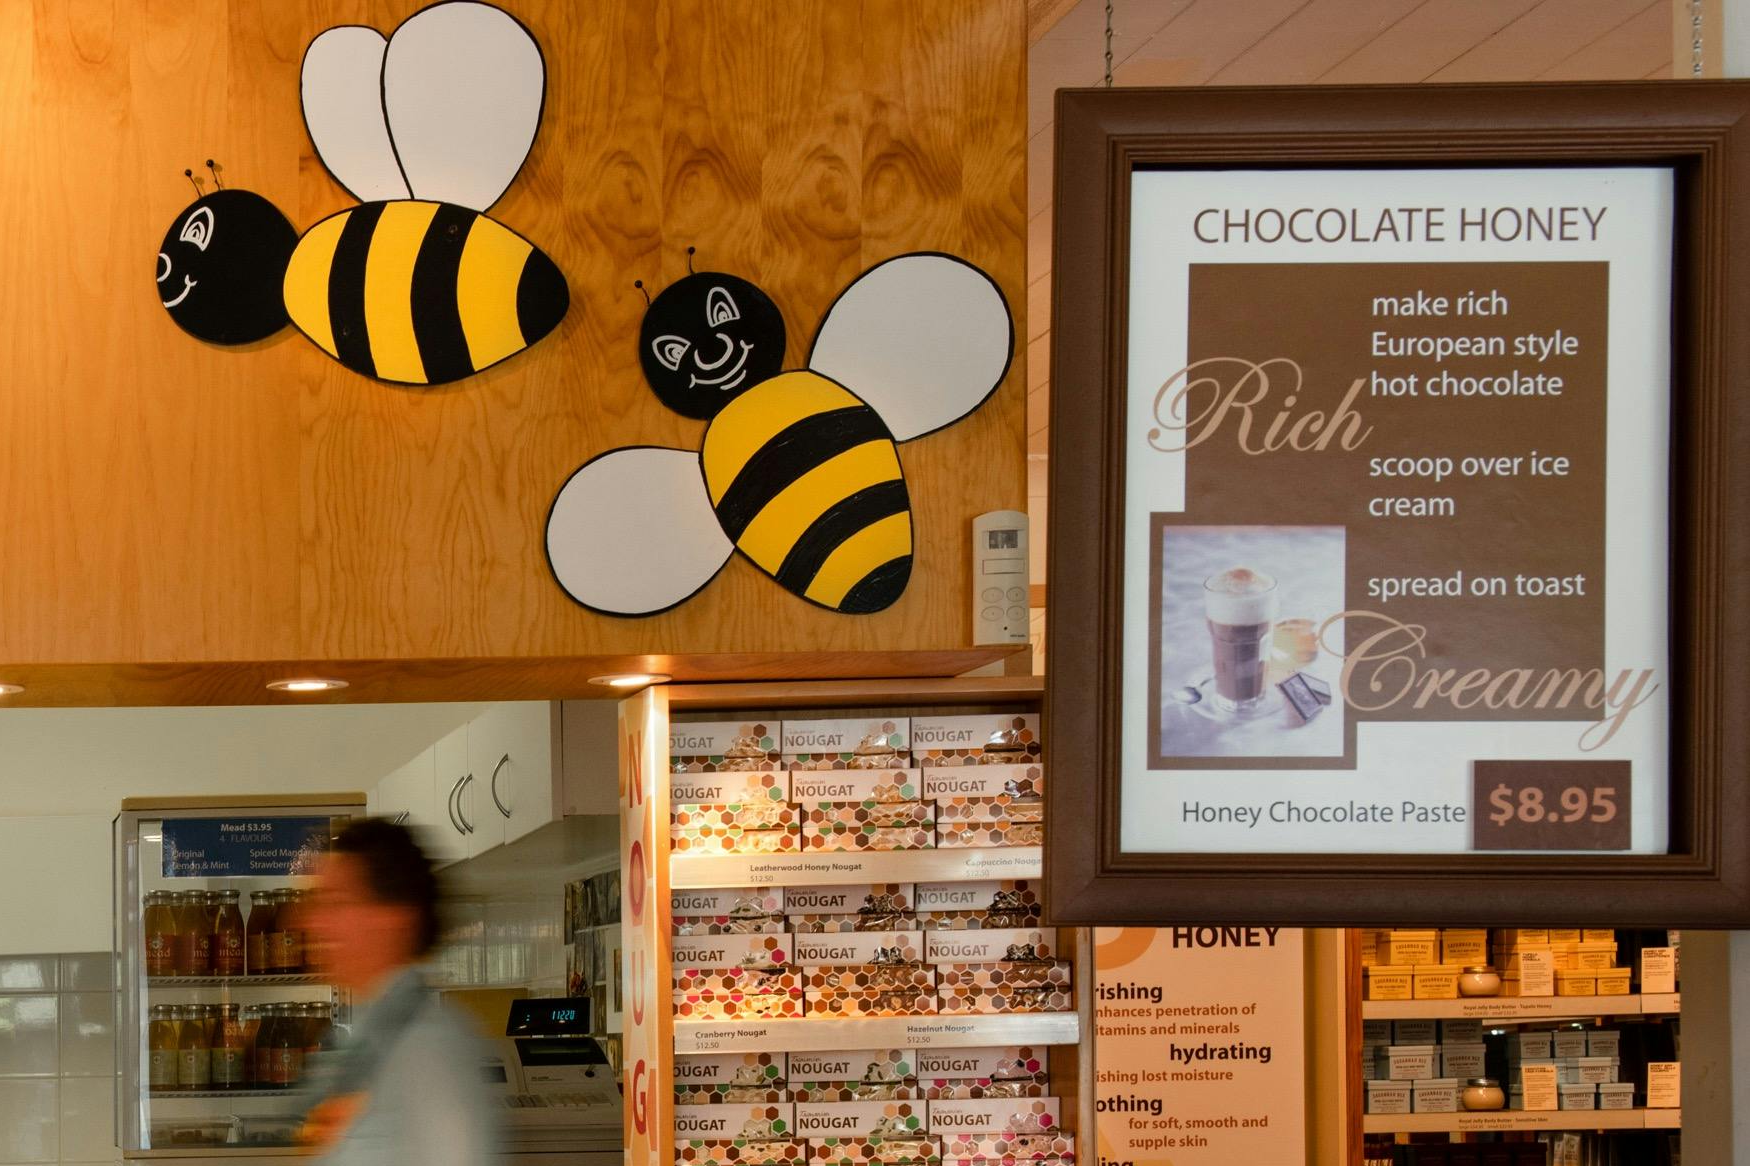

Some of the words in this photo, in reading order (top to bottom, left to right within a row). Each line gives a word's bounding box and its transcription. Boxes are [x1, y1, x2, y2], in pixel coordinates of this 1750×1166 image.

[1193, 207, 1445, 244] CHOCOLATE
[1459, 205, 1607, 242] HONEY
[1372, 291, 1448, 317] make
[1457, 290, 1507, 316] rich
[1371, 330, 1505, 363] European
[1513, 329, 1578, 361] style
[1371, 371, 1417, 397] hot
[1425, 370, 1563, 397] chocolate
[1147, 356, 1373, 456] Rich
[1369, 455, 1452, 485] scoop
[1460, 456, 1522, 477] over
[1529, 451, 1569, 477] ice
[1368, 496, 1454, 517] cream
[1367, 572, 1462, 603] spread
[1470, 577, 1506, 597] on
[1514, 572, 1584, 597] toast
[1317, 609, 1660, 752] Creamy
[671, 737, 715, 749] OUGAT
[785, 734, 843, 747] NOUGAT
[914, 730, 973, 743] NOUGAT
[796, 785, 855, 797] NOUGAT
[927, 781, 987, 793] NOUGAT
[1182, 801, 1261, 828] Honey
[1268, 799, 1394, 824] Chocolate
[1401, 800, 1466, 823] Paste
[1488, 785, 1617, 825] $8.95
[221, 823, 245, 831] Mead
[247, 823, 272, 831] $3.95
[231, 834, 273, 842] FLAVOURS
[250, 849, 278, 858] Spiced
[750, 864, 803, 872] Leatherwood
[805, 863, 830, 872] Honey
[832, 863, 862, 872] Nougat
[787, 895, 847, 908] NOUGAT
[918, 891, 976, 904] NOUGAT
[1172, 927, 1281, 948] HONEY
[797, 947, 857, 960] NOUGAT
[929, 945, 989, 957] NOUGAT
[1096, 1006, 1152, 1018] nhances
[1155, 1004, 1238, 1019] penetration
[1241, 1003, 1257, 1015] of
[695, 1031, 736, 1039] Cranberry
[737, 1029, 767, 1038] Nougat
[907, 1025, 943, 1033] Hazelnut
[944, 1024, 975, 1033] Nougat
[1096, 1023, 1146, 1036] itamins
[1150, 1022, 1176, 1035] and
[1180, 1021, 1240, 1034] minerals
[695, 1041, 719, 1049] $12.50
[1169, 1042, 1272, 1065] hydrating
[791, 1062, 850, 1075] NOUGAT
[919, 1060, 980, 1072] NOUGAT
[1096, 1070, 1138, 1085] ishing
[1142, 1069, 1168, 1082] lost
[1171, 1068, 1233, 1081] moisture
[1096, 1094, 1163, 1115] othing
[800, 1117, 859, 1129] NOUGAT
[932, 1114, 992, 1126] NOUGAT
[1128, 1117, 1148, 1130] for
[1152, 1116, 1182, 1131] soft,
[1185, 1115, 1238, 1129] smooth
[1242, 1115, 1268, 1128] and
[1128, 1135, 1175, 1150] supple
[1179, 1133, 1207, 1147] skin
